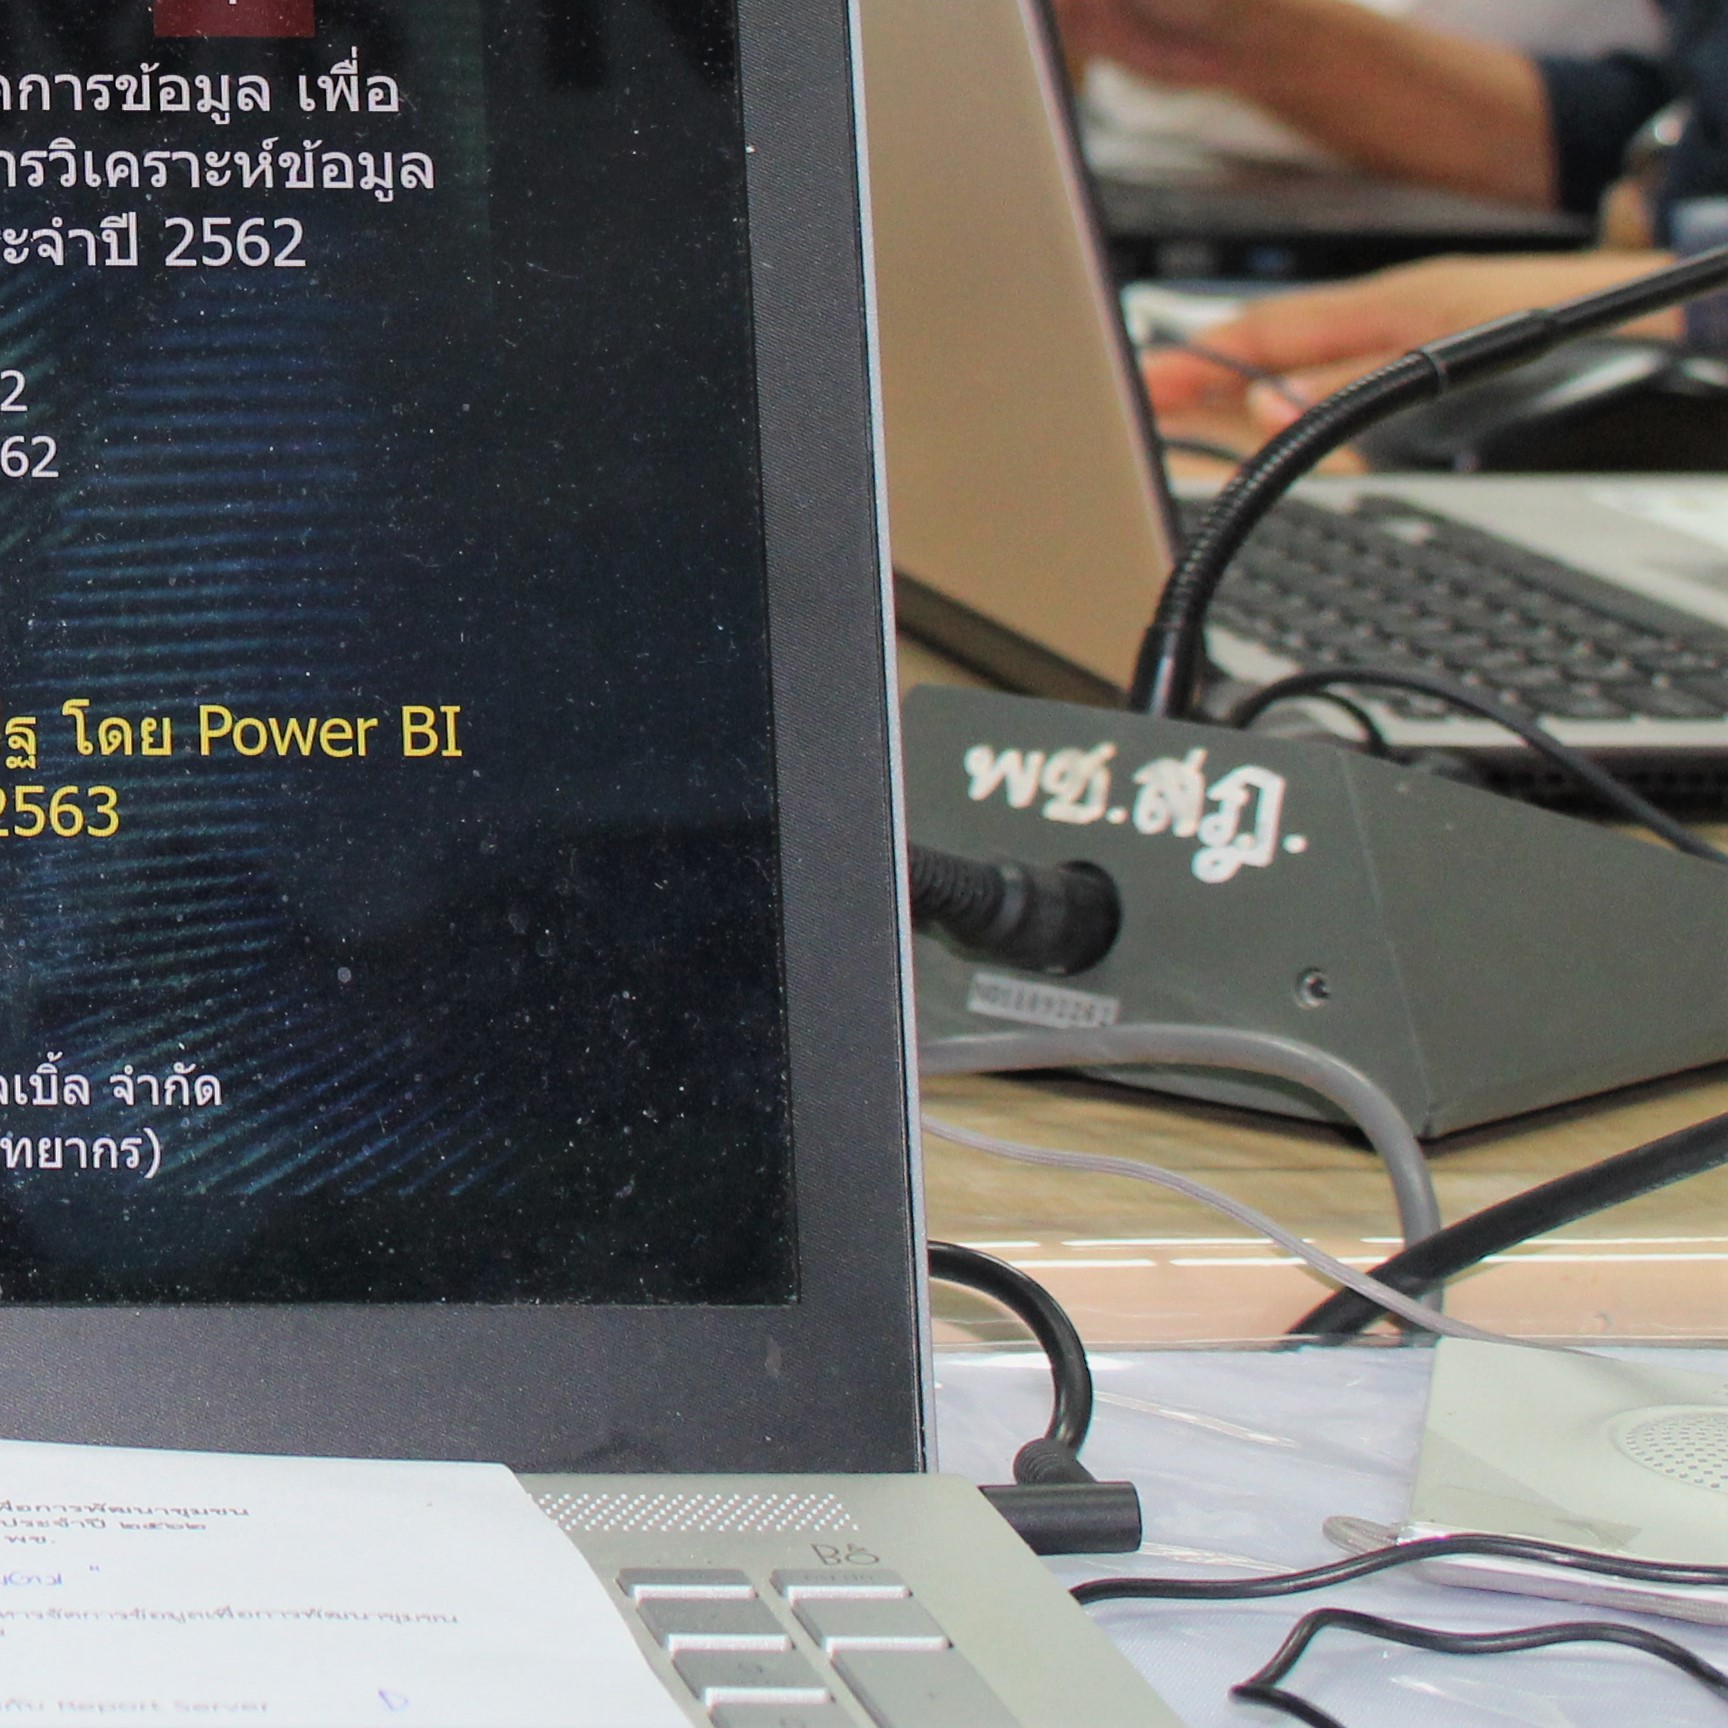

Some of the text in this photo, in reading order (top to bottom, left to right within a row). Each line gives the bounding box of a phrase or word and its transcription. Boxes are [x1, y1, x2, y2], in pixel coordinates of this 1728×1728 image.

[299, 59, 399, 112] เพื่อ
[165, 217, 305, 267] 2562
[62, 699, 172, 756] โดย
[200, 705, 378, 757] Power
[402, 706, 462, 757] BI
[110, 1062, 221, 1105] จำกัด
